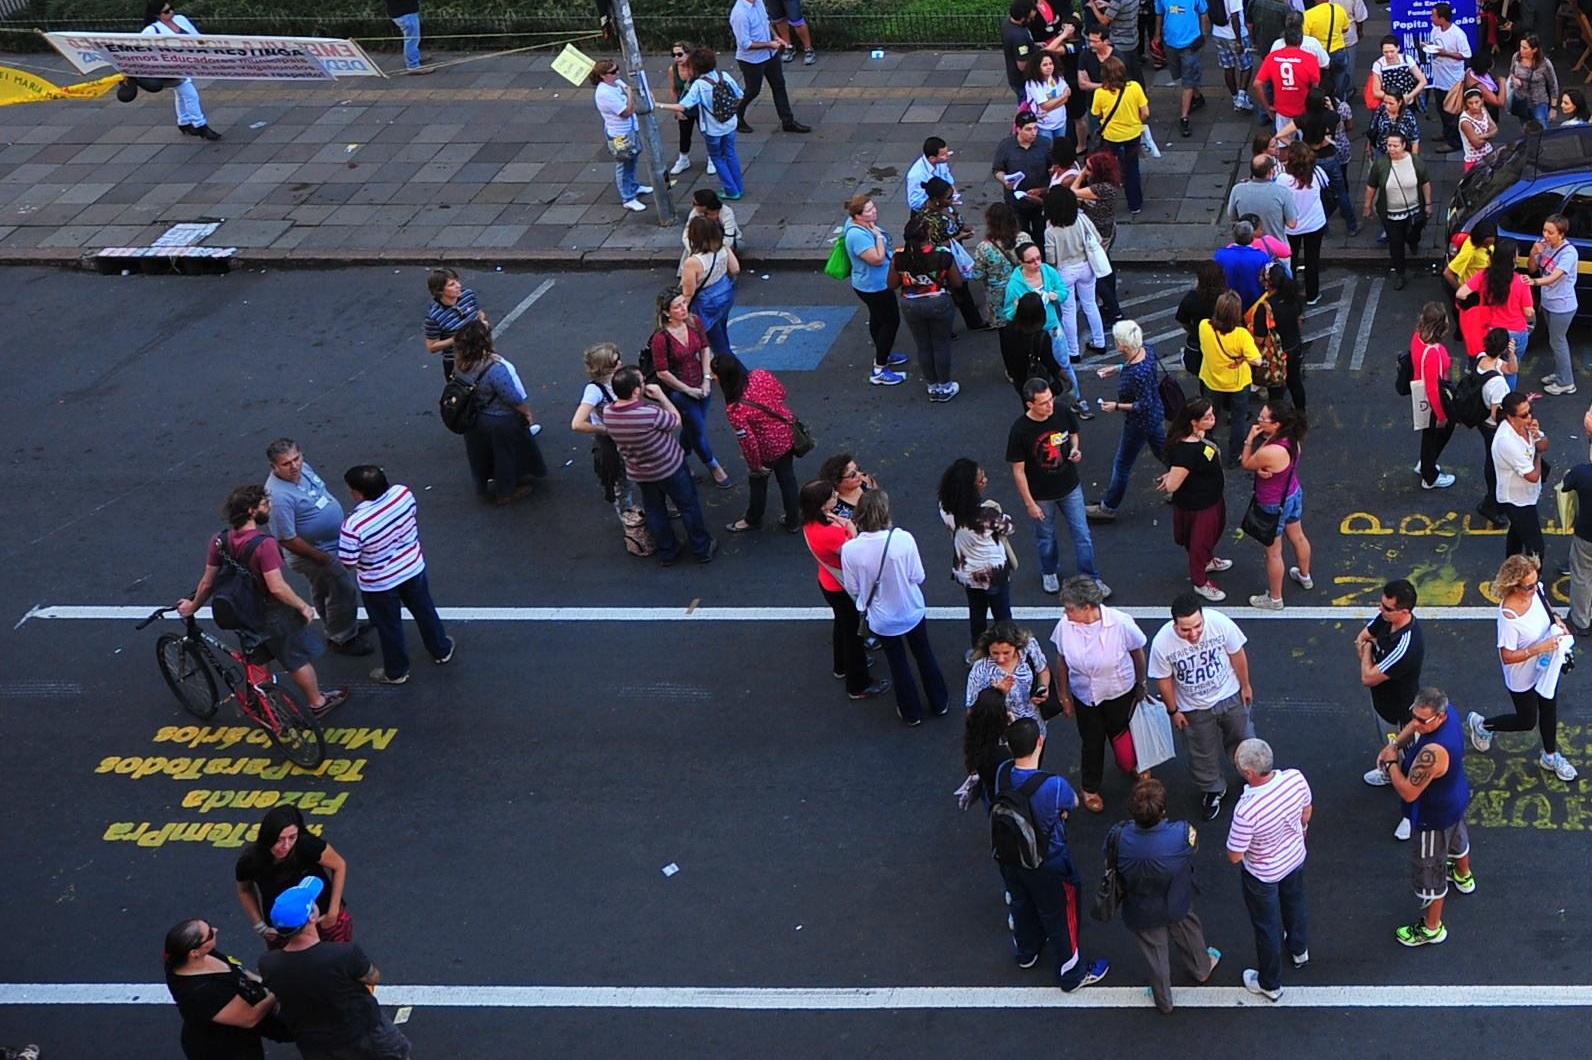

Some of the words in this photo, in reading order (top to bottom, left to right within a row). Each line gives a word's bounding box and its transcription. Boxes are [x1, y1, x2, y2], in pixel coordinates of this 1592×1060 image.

[112, 53, 160, 62] Somos
[162, 54, 236, 64] Educadores
[14, 76, 43, 94] MARIA
[1280, 62, 1295, 86] 9
[1177, 656, 1224, 685] BEACH
[180, 788, 350, 816] Fazenda
